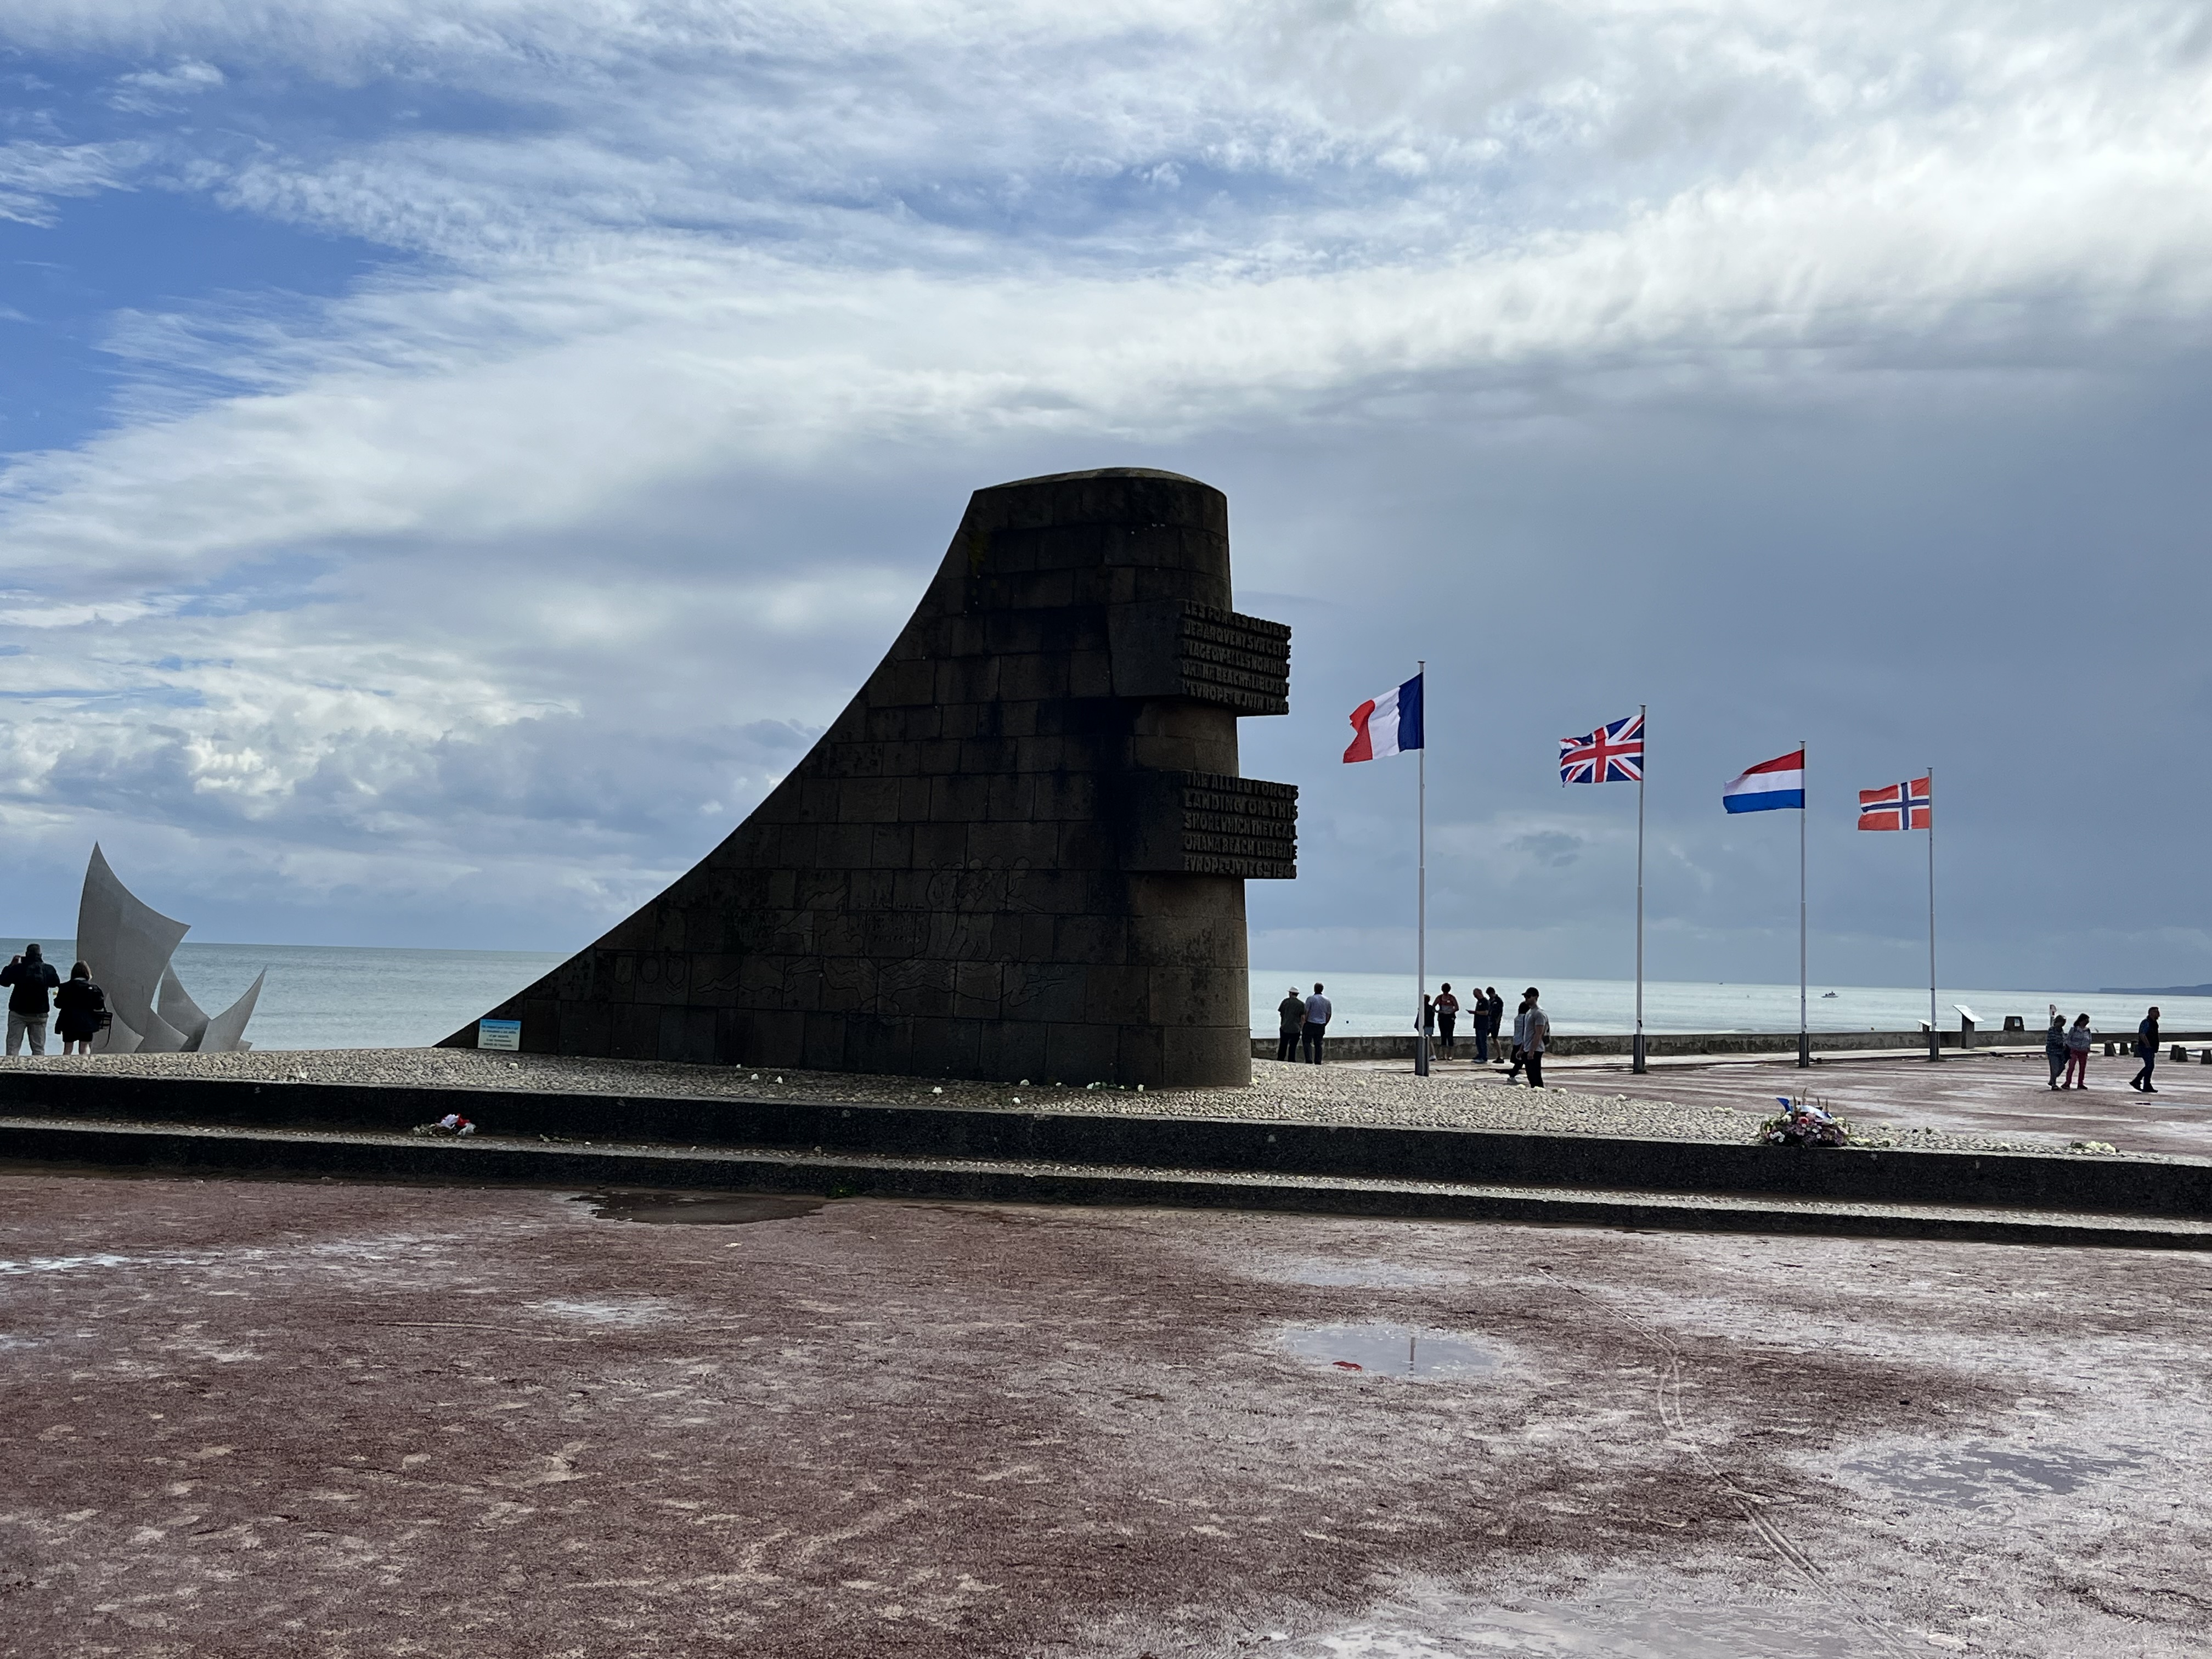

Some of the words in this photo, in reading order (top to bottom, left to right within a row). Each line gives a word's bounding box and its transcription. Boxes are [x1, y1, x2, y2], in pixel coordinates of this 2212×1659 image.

[1186, 771, 1209, 788] THE
[1211, 774, 1252, 794] ALLIED
[1255, 782, 1299, 799] FORCES
[1184, 789, 1246, 814] LANDING
[1248, 800, 1265, 816] ON
[1270, 802, 1298, 820] THIS
[1184, 812, 1220, 832] SHORE
[1251, 821, 1274, 837] THEY
[1276, 823, 1297, 840] CALL
[1185, 835, 1222, 853] OMAHA
[1222, 838, 1255, 856] BEACH
[1257, 841, 1297, 859] LIBERATE
